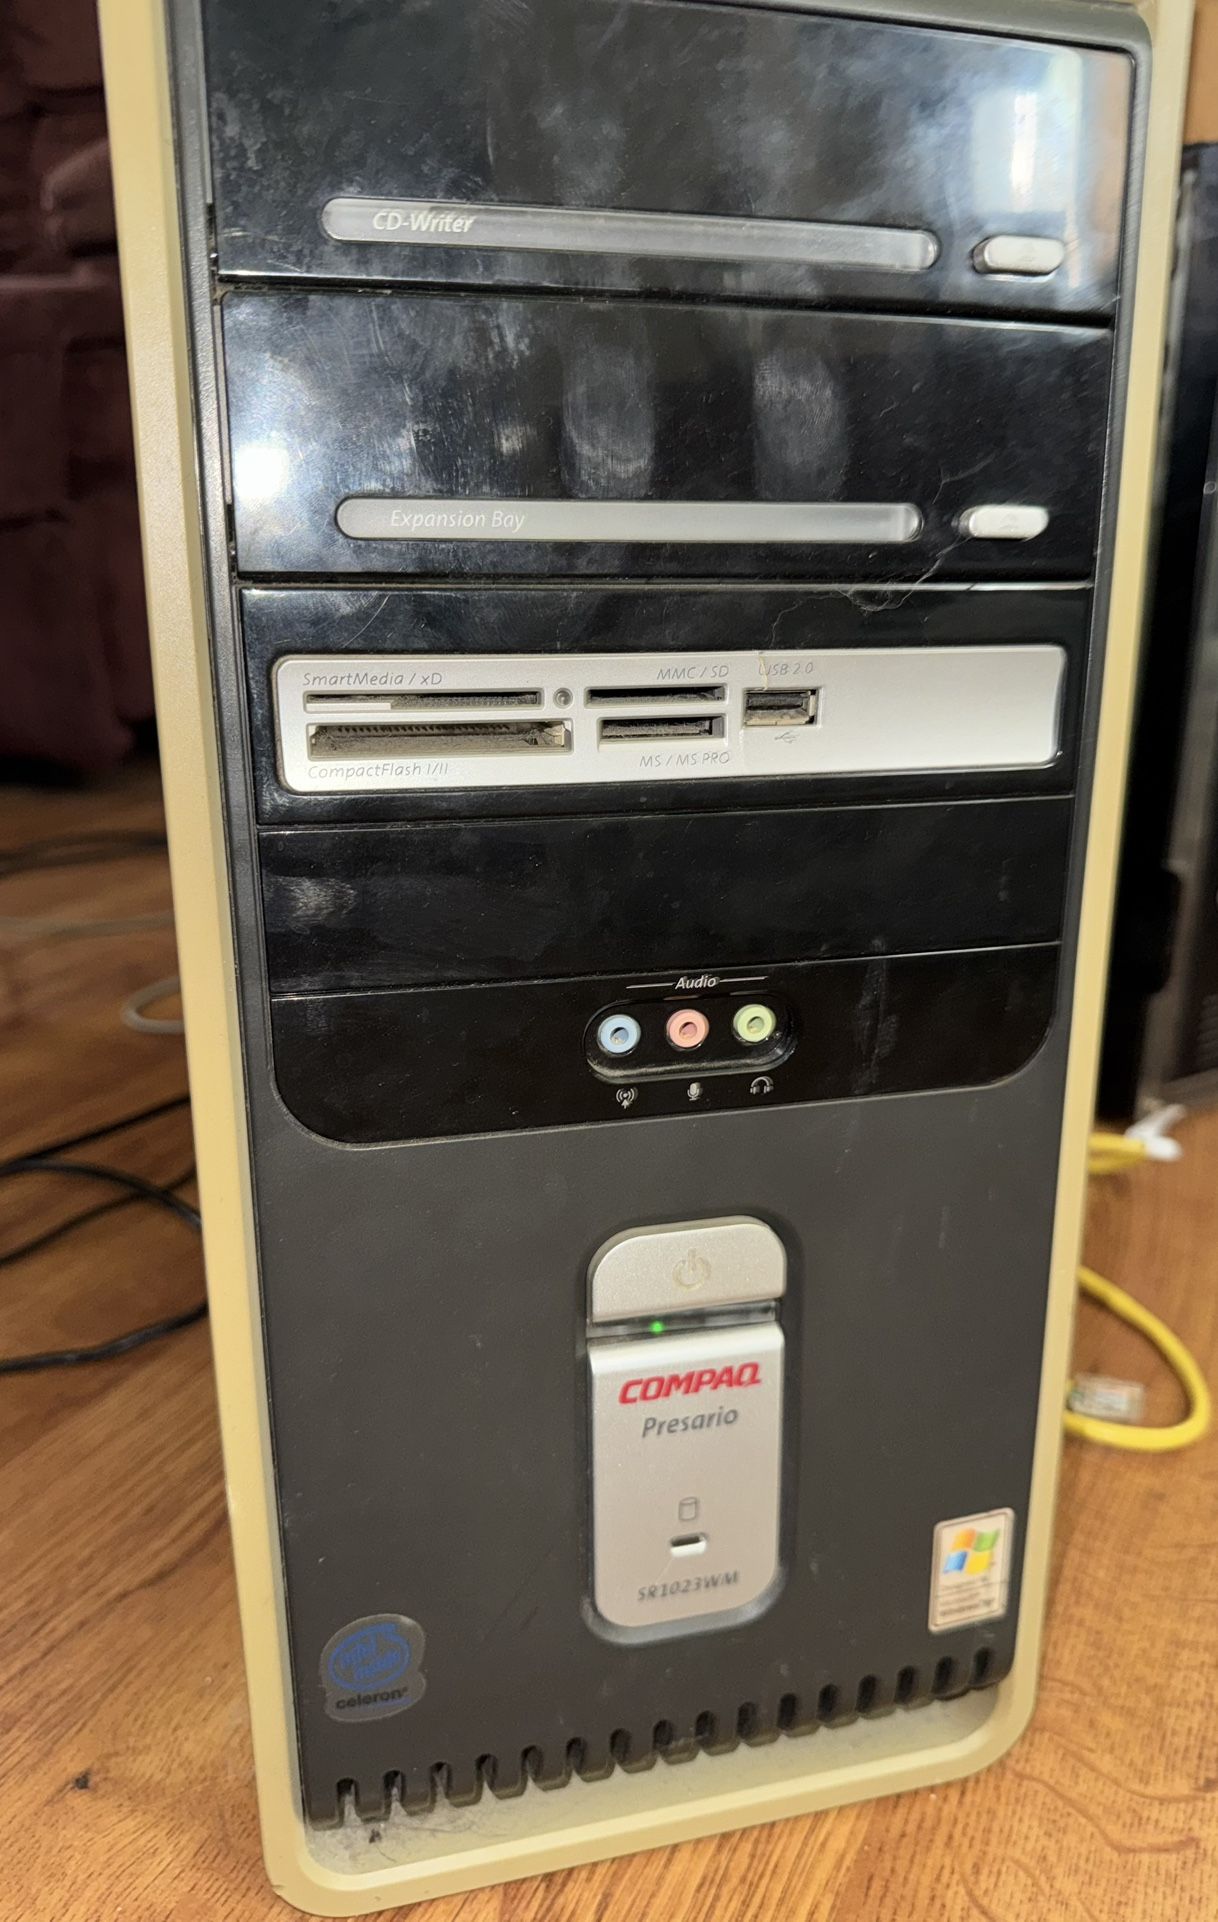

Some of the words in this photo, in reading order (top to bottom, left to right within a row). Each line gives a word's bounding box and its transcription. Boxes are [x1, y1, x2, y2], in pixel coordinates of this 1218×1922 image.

[372, 209, 476, 233] CD-Writer
[391, 510, 485, 531] Expansion
[491, 511, 525, 532] Bay
[656, 666, 696, 680] MMC
[711, 665, 729, 678] SD
[758, 663, 789, 676] USB
[302, 672, 404, 686] SmartMedia
[420, 672, 442, 685] xD
[639, 755, 662, 767] MS
[676, 753, 697, 766] MS
[701, 752, 730, 765] PRO
[308, 763, 421, 780] CompactFlash
[675, 975, 719, 989] Audio
[619, 1362, 762, 1404] COMPAQ
[641, 1406, 738, 1438] Presario
[637, 1570, 739, 1601] SR1023WM
